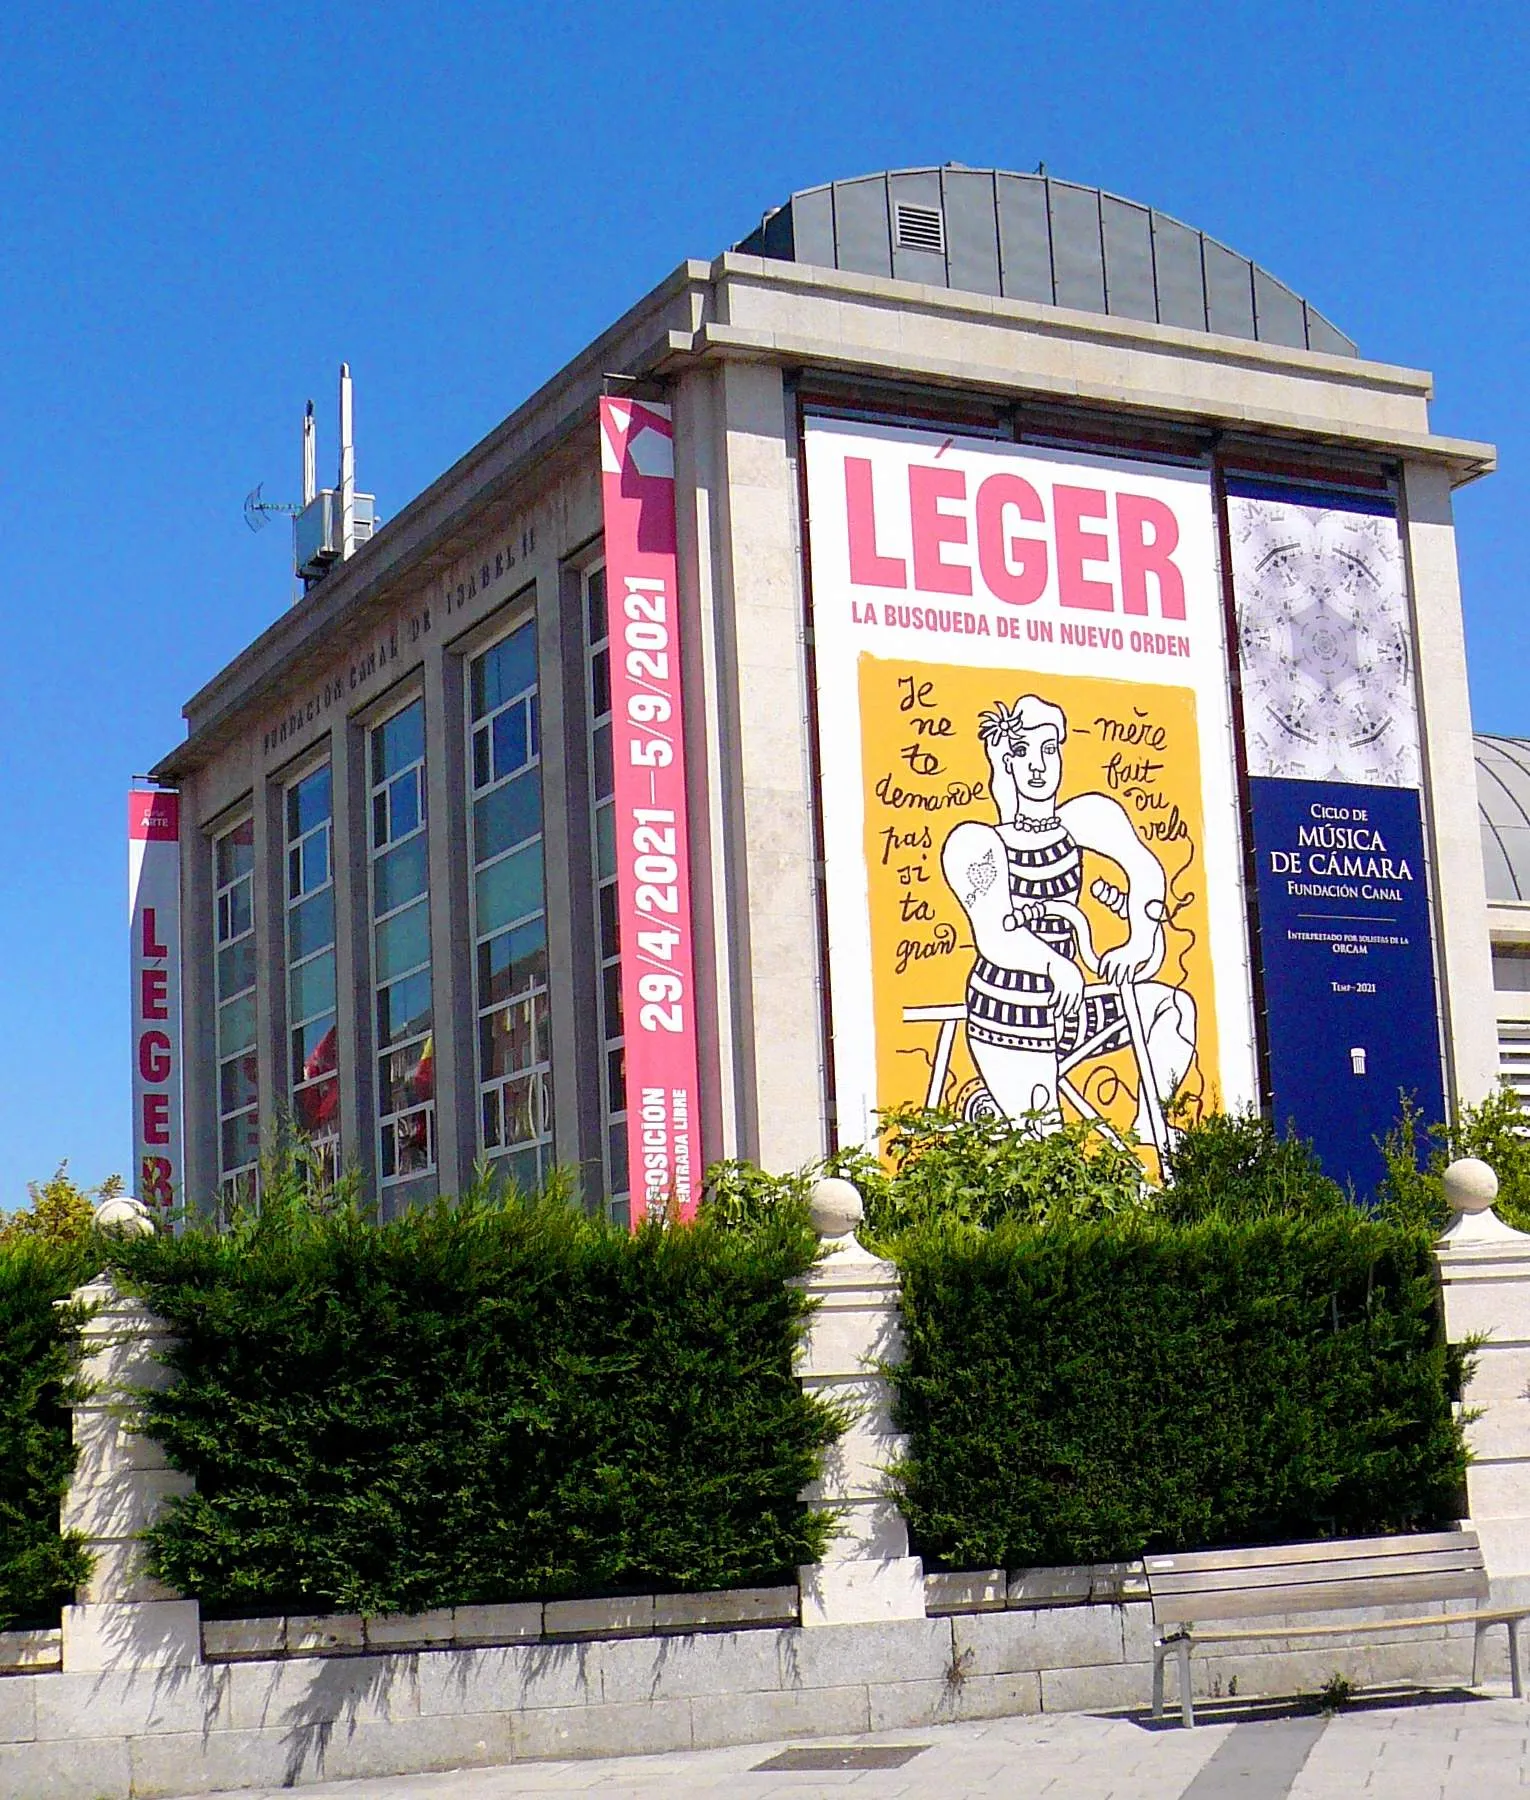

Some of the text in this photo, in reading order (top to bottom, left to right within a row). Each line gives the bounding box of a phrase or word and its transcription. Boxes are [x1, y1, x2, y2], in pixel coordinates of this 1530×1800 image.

[844, 438, 1187, 620] LÉGER
[350, 634, 398, 690] CANAL
[446, 546, 515, 614] ISABEL
[851, 600, 1191, 658] LA BUSQUEDA DE UN NUEVO ORDEN
[898, 676, 938, 712] Je
[910, 717, 957, 737] ne
[901, 743, 948, 776] te
[1101, 752, 1165, 790] fait
[875, 772, 990, 812] demande
[1123, 787, 1170, 812] du
[879, 826, 933, 866] pas
[1297, 823, 1388, 852] MÚSICA
[896, 854, 931, 885] si
[1270, 850, 1414, 881] DE CÁMARA
[898, 891, 936, 923] ta
[139, 908, 174, 1207] LÉGER
[672, 1088, 691, 1204] ENTRADA LIBRE
